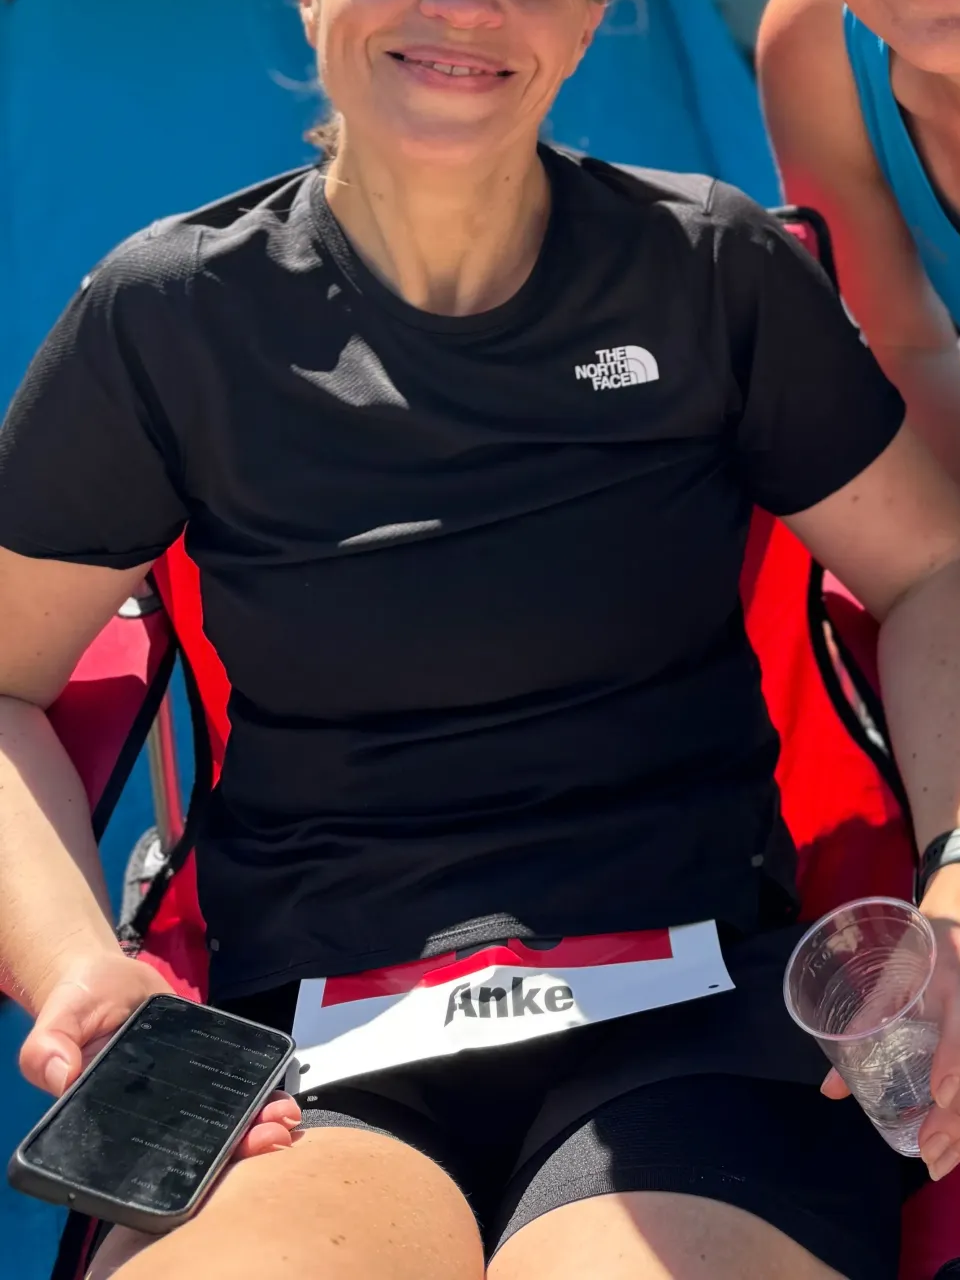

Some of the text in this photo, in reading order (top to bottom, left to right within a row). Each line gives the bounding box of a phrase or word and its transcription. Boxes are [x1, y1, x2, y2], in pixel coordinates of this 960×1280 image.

[595, 347, 627, 363] THE
[574, 359, 629, 380] NORTH
[592, 372, 633, 391] FACE
[443, 976, 574, 1028] Anke
